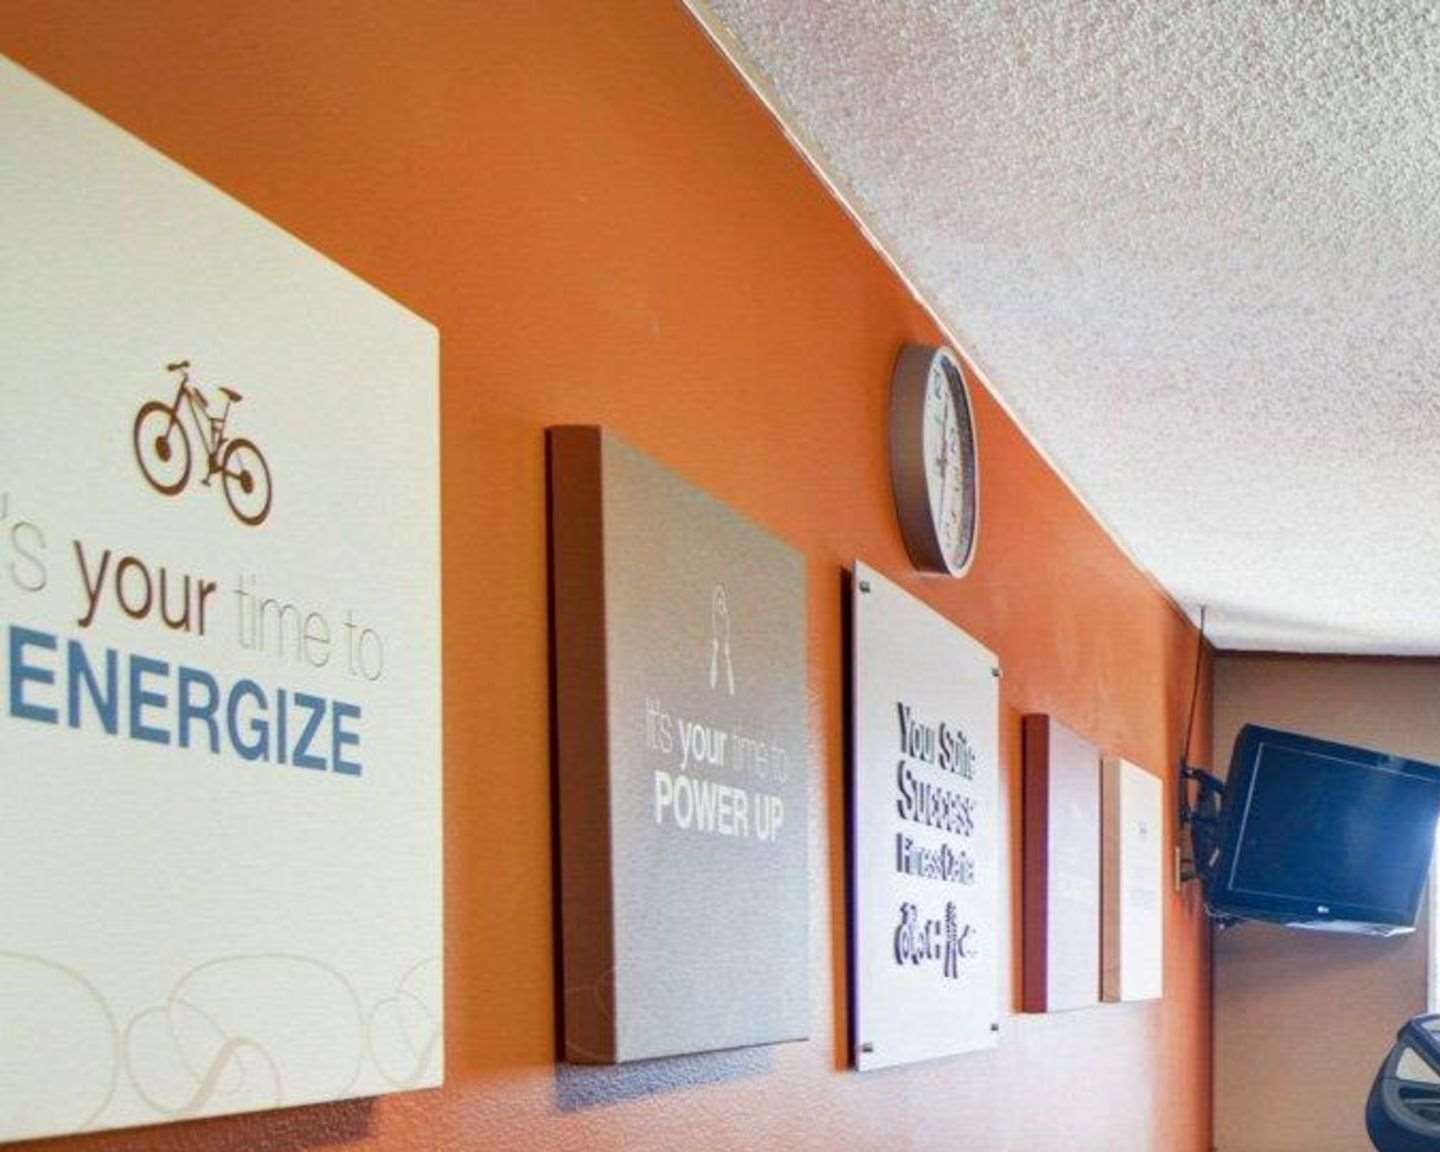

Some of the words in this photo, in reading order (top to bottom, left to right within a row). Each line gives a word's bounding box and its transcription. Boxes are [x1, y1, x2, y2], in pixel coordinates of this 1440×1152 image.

[73, 539, 217, 636] your
[233, 571, 331, 669] time
[344, 608, 385, 683] to
[9, 625, 364, 777] ENERGIZE
[678, 719, 728, 770] your
[654, 770, 749, 838] POWER
[755, 793, 785, 842] UP
